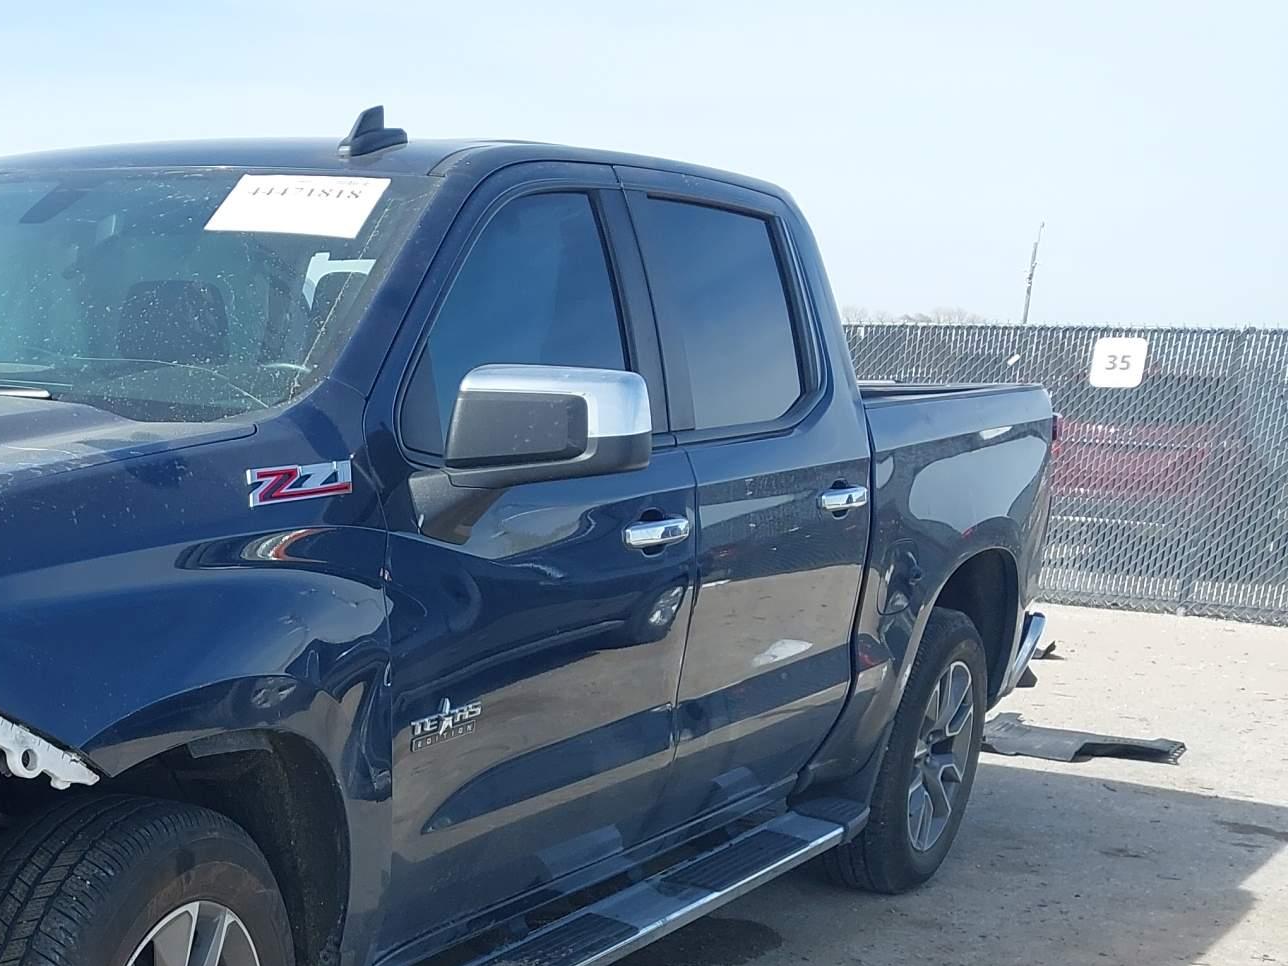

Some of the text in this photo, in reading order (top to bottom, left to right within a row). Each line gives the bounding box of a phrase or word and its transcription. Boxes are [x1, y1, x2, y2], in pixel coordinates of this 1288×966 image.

[1104, 354, 1132, 371] 35
[410, 698, 483, 736] TEXAS
[416, 723, 474, 749] EDITION
